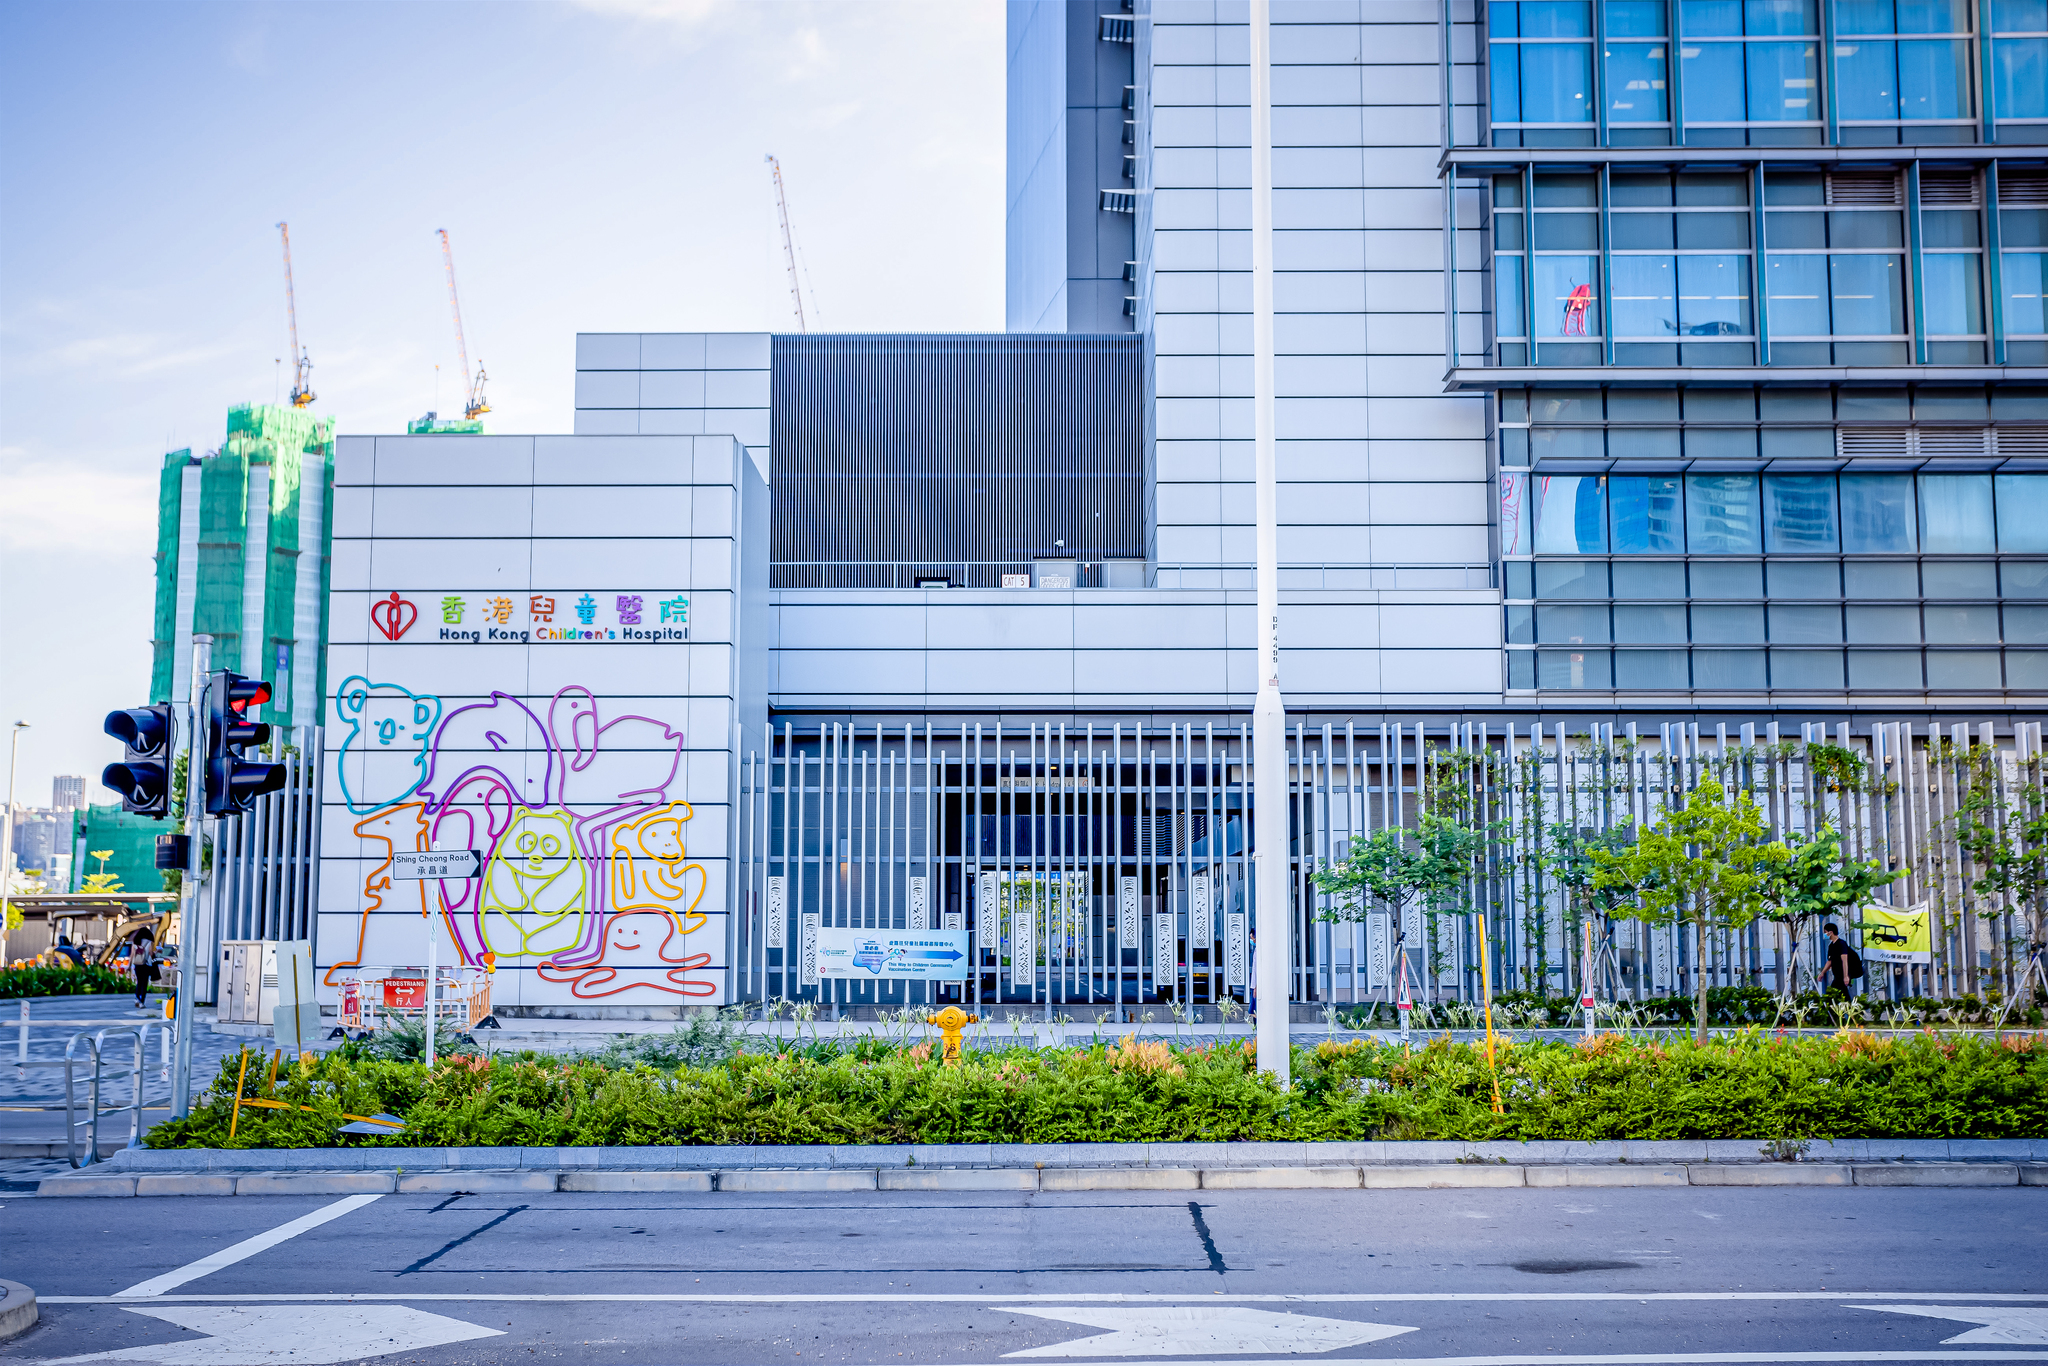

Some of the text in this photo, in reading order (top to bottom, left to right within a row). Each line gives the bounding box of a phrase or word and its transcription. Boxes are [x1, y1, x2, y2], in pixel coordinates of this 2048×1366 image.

[441, 593, 689, 625] 香港兒童醫院
[439, 627, 688, 643] Hong Kong Children's Hospital
[396, 855, 417, 864] Shing
[418, 855, 448, 863] Cheong
[417, 865, 448, 875] 承昌道
[396, 997, 412, 1006] 行人
